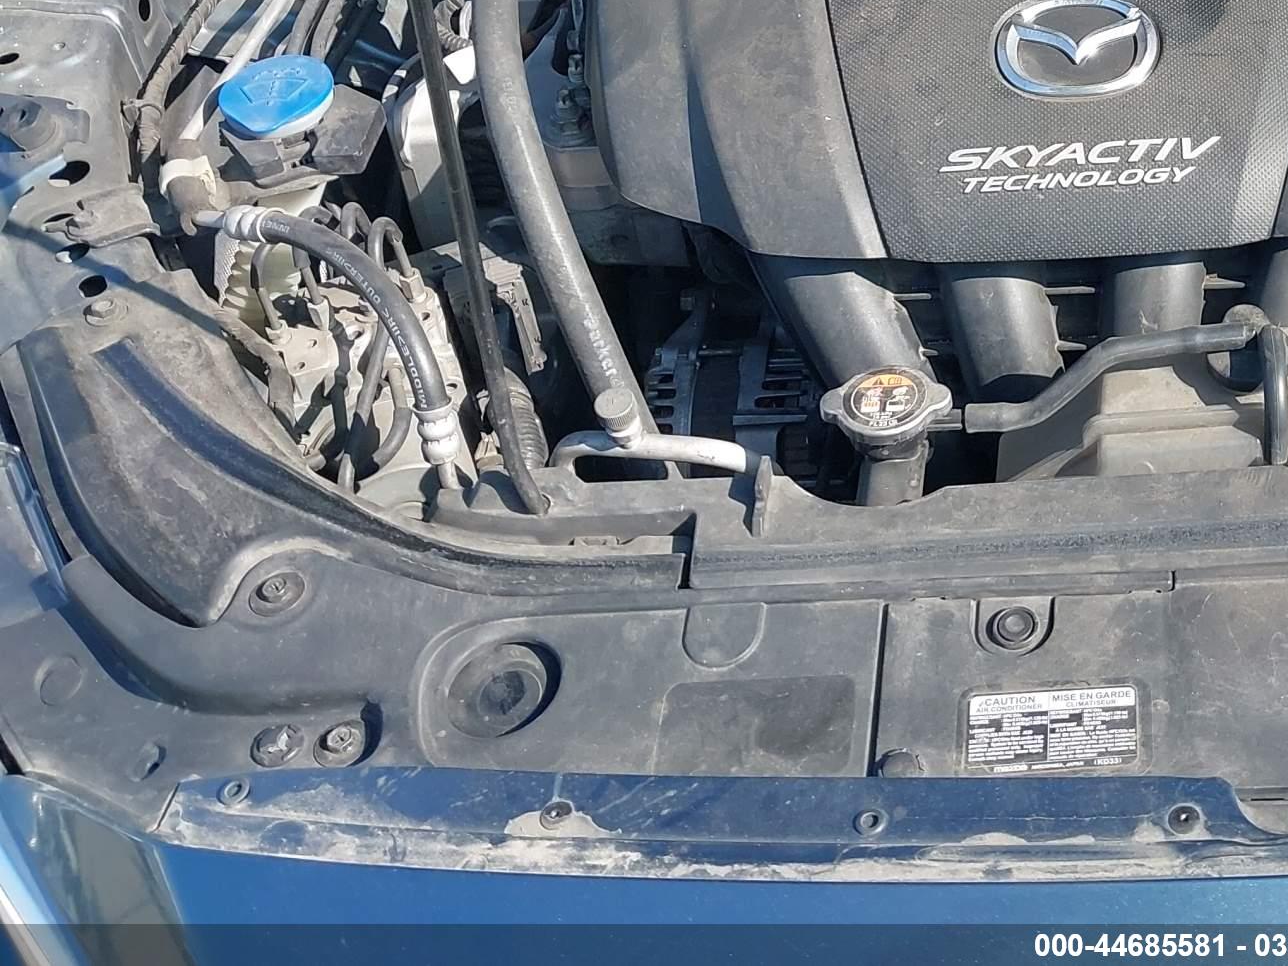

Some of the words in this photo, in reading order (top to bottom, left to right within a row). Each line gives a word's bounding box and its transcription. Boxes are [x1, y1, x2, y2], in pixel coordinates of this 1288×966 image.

[939, 135, 1222, 173] SKYACTIV
[961, 166, 1196, 194] TECHNOLOGY
[984, 696, 1036, 707] CAUTION
[1052, 693, 1077, 702] MISE
[1079, 692, 1093, 700] EN
[1095, 690, 1132, 699] GARDE
[990, 704, 1043, 713] CONDITIONER
[1065, 699, 1117, 708] CLIMATISEUR
